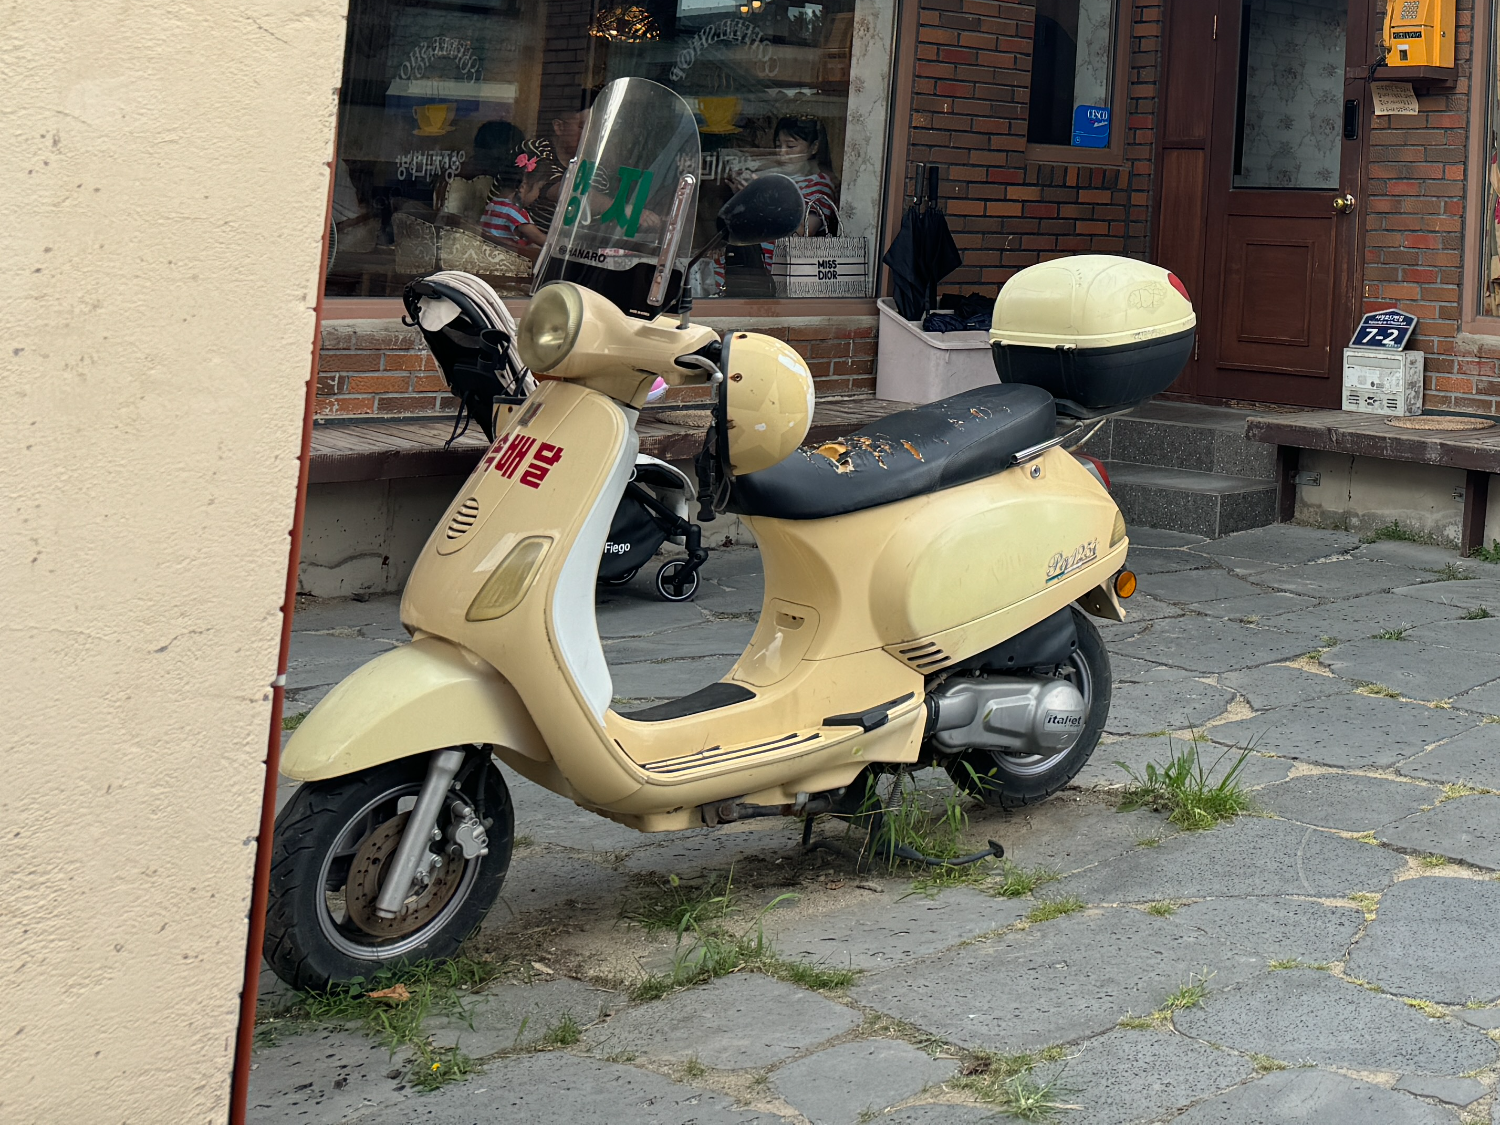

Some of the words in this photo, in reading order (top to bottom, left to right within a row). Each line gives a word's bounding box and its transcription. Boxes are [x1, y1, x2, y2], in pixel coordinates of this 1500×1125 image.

[817, 259, 838, 270] MISS
[817, 270, 839, 281] DIOR
[1362, 328, 1400, 345] 7-2
[604, 541, 631, 555] Fiego
